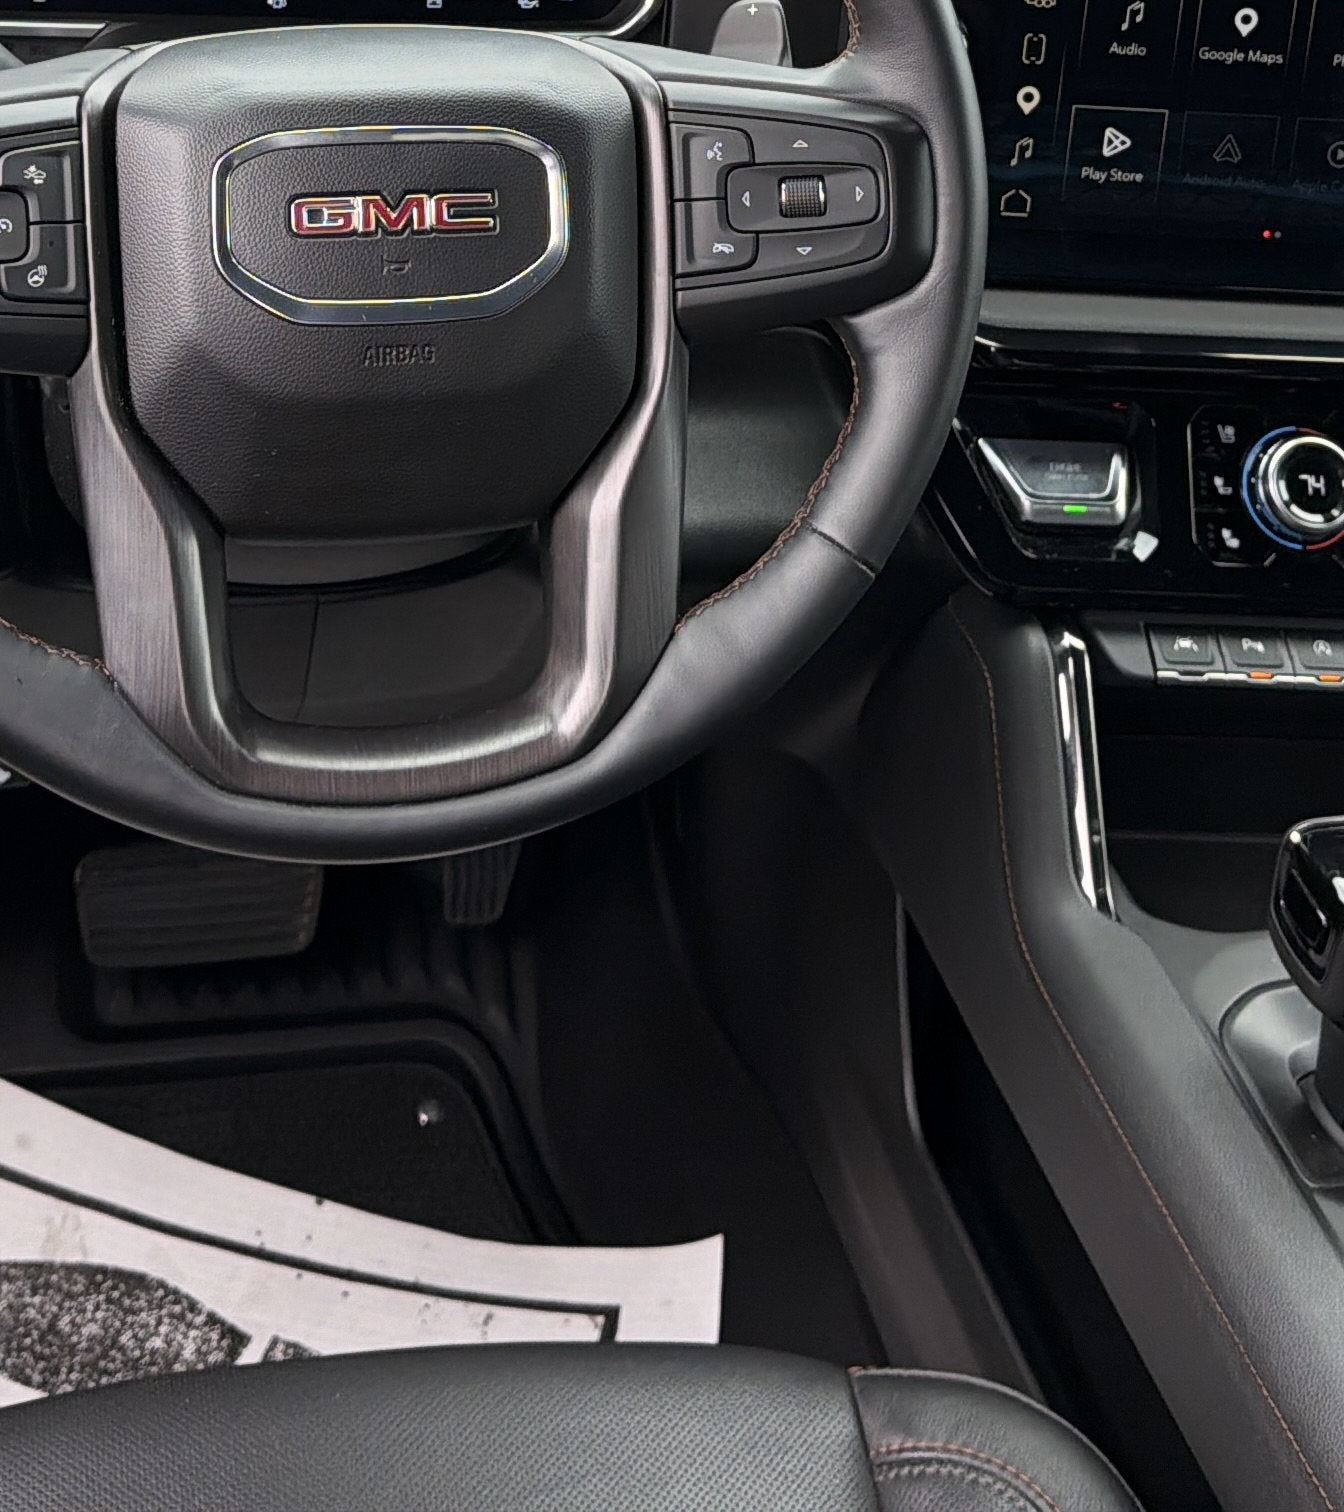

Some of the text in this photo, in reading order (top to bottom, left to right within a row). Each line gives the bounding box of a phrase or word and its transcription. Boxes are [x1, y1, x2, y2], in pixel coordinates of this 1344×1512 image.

[1109, 42, 1147, 57] Audio
[1198, 47, 1284, 66] Google Maps
[1081, 167, 1144, 183] Play Store
[290, 192, 496, 236] GMC
[362, 344, 436, 367] AIRBAG
[1299, 474, 1326, 496] 74
